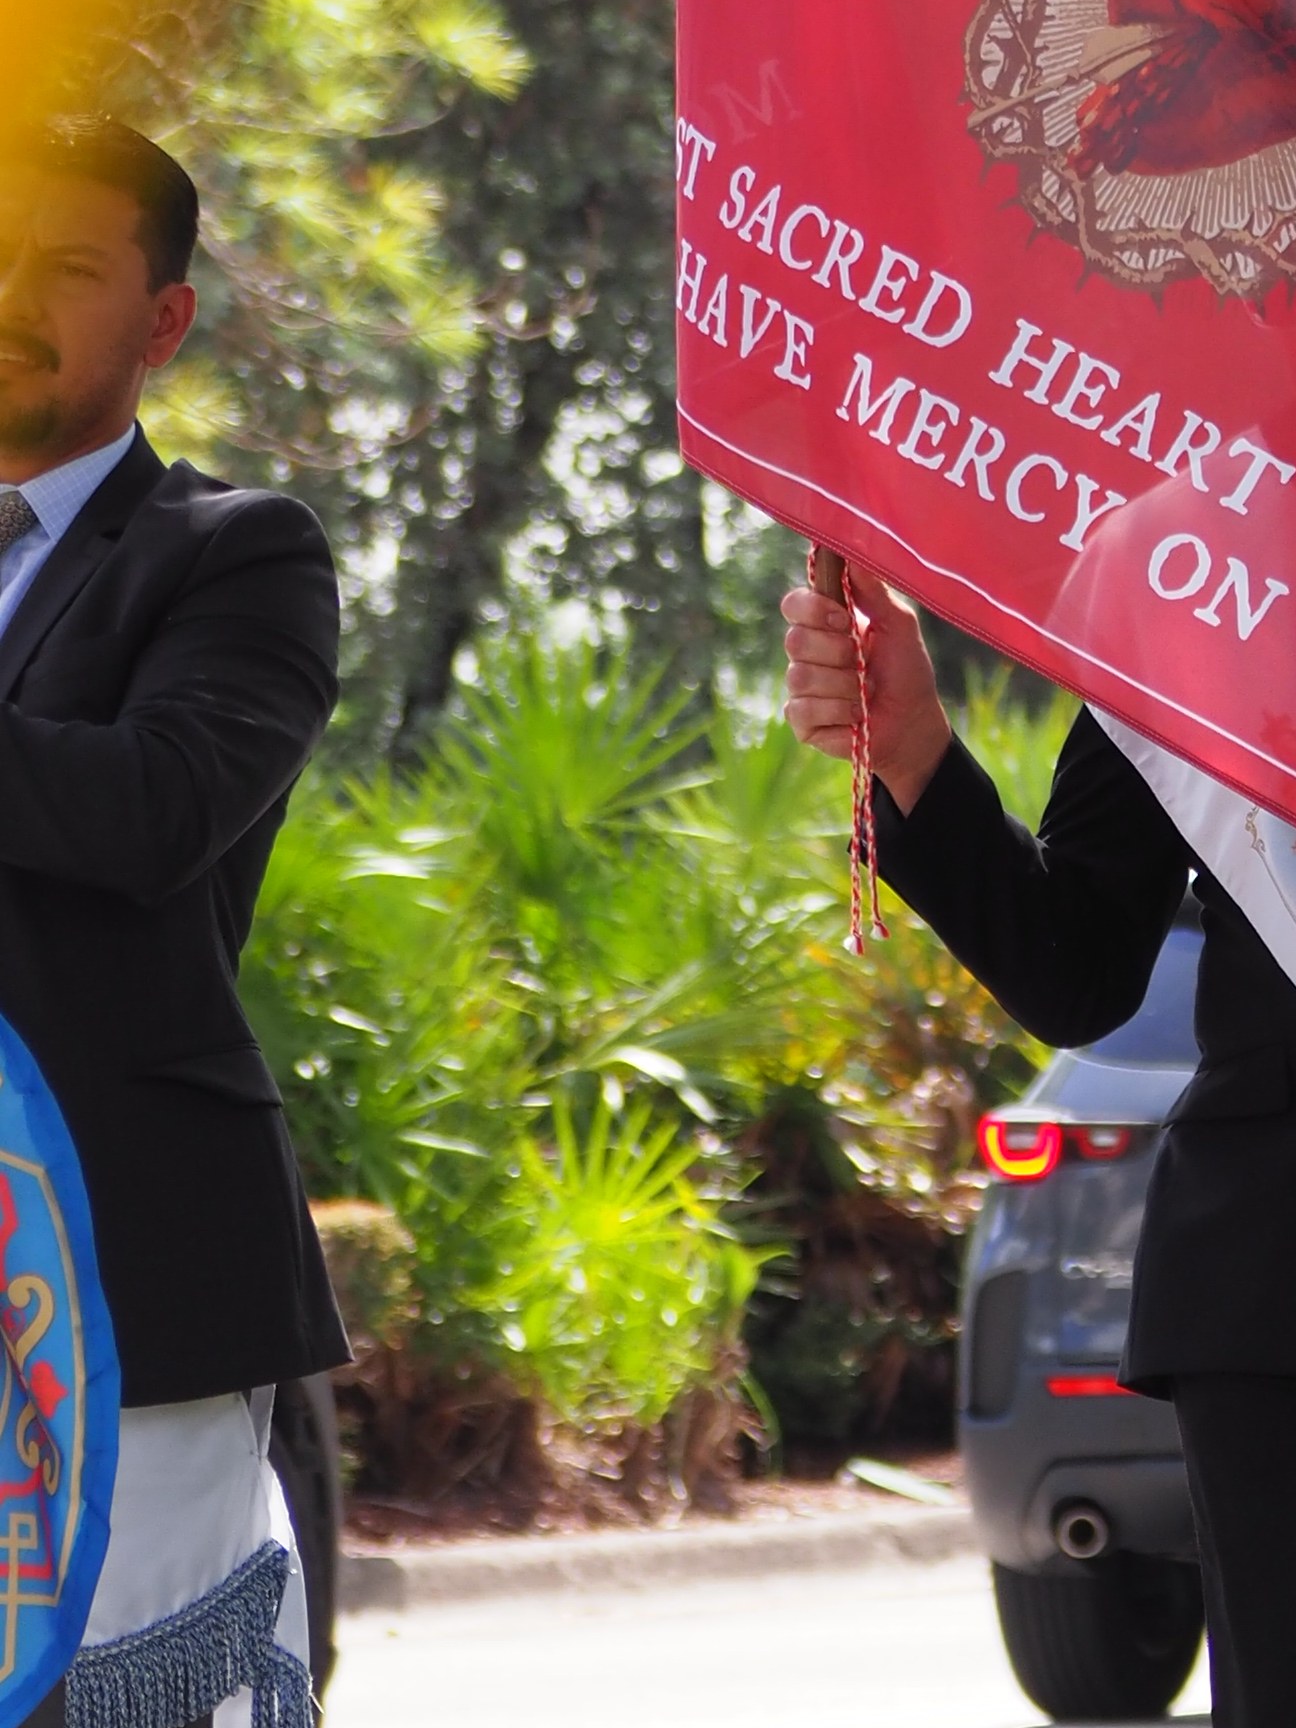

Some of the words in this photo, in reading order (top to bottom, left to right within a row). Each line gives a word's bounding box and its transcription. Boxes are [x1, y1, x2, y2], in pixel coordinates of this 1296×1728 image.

[676, 238, 814, 390] HAVE
[843, 352, 1127, 553] MERCY
[1148, 532, 1290, 641] ON
[719, 166, 973, 348] SACRED
[988, 319, 1296, 516] HEART
